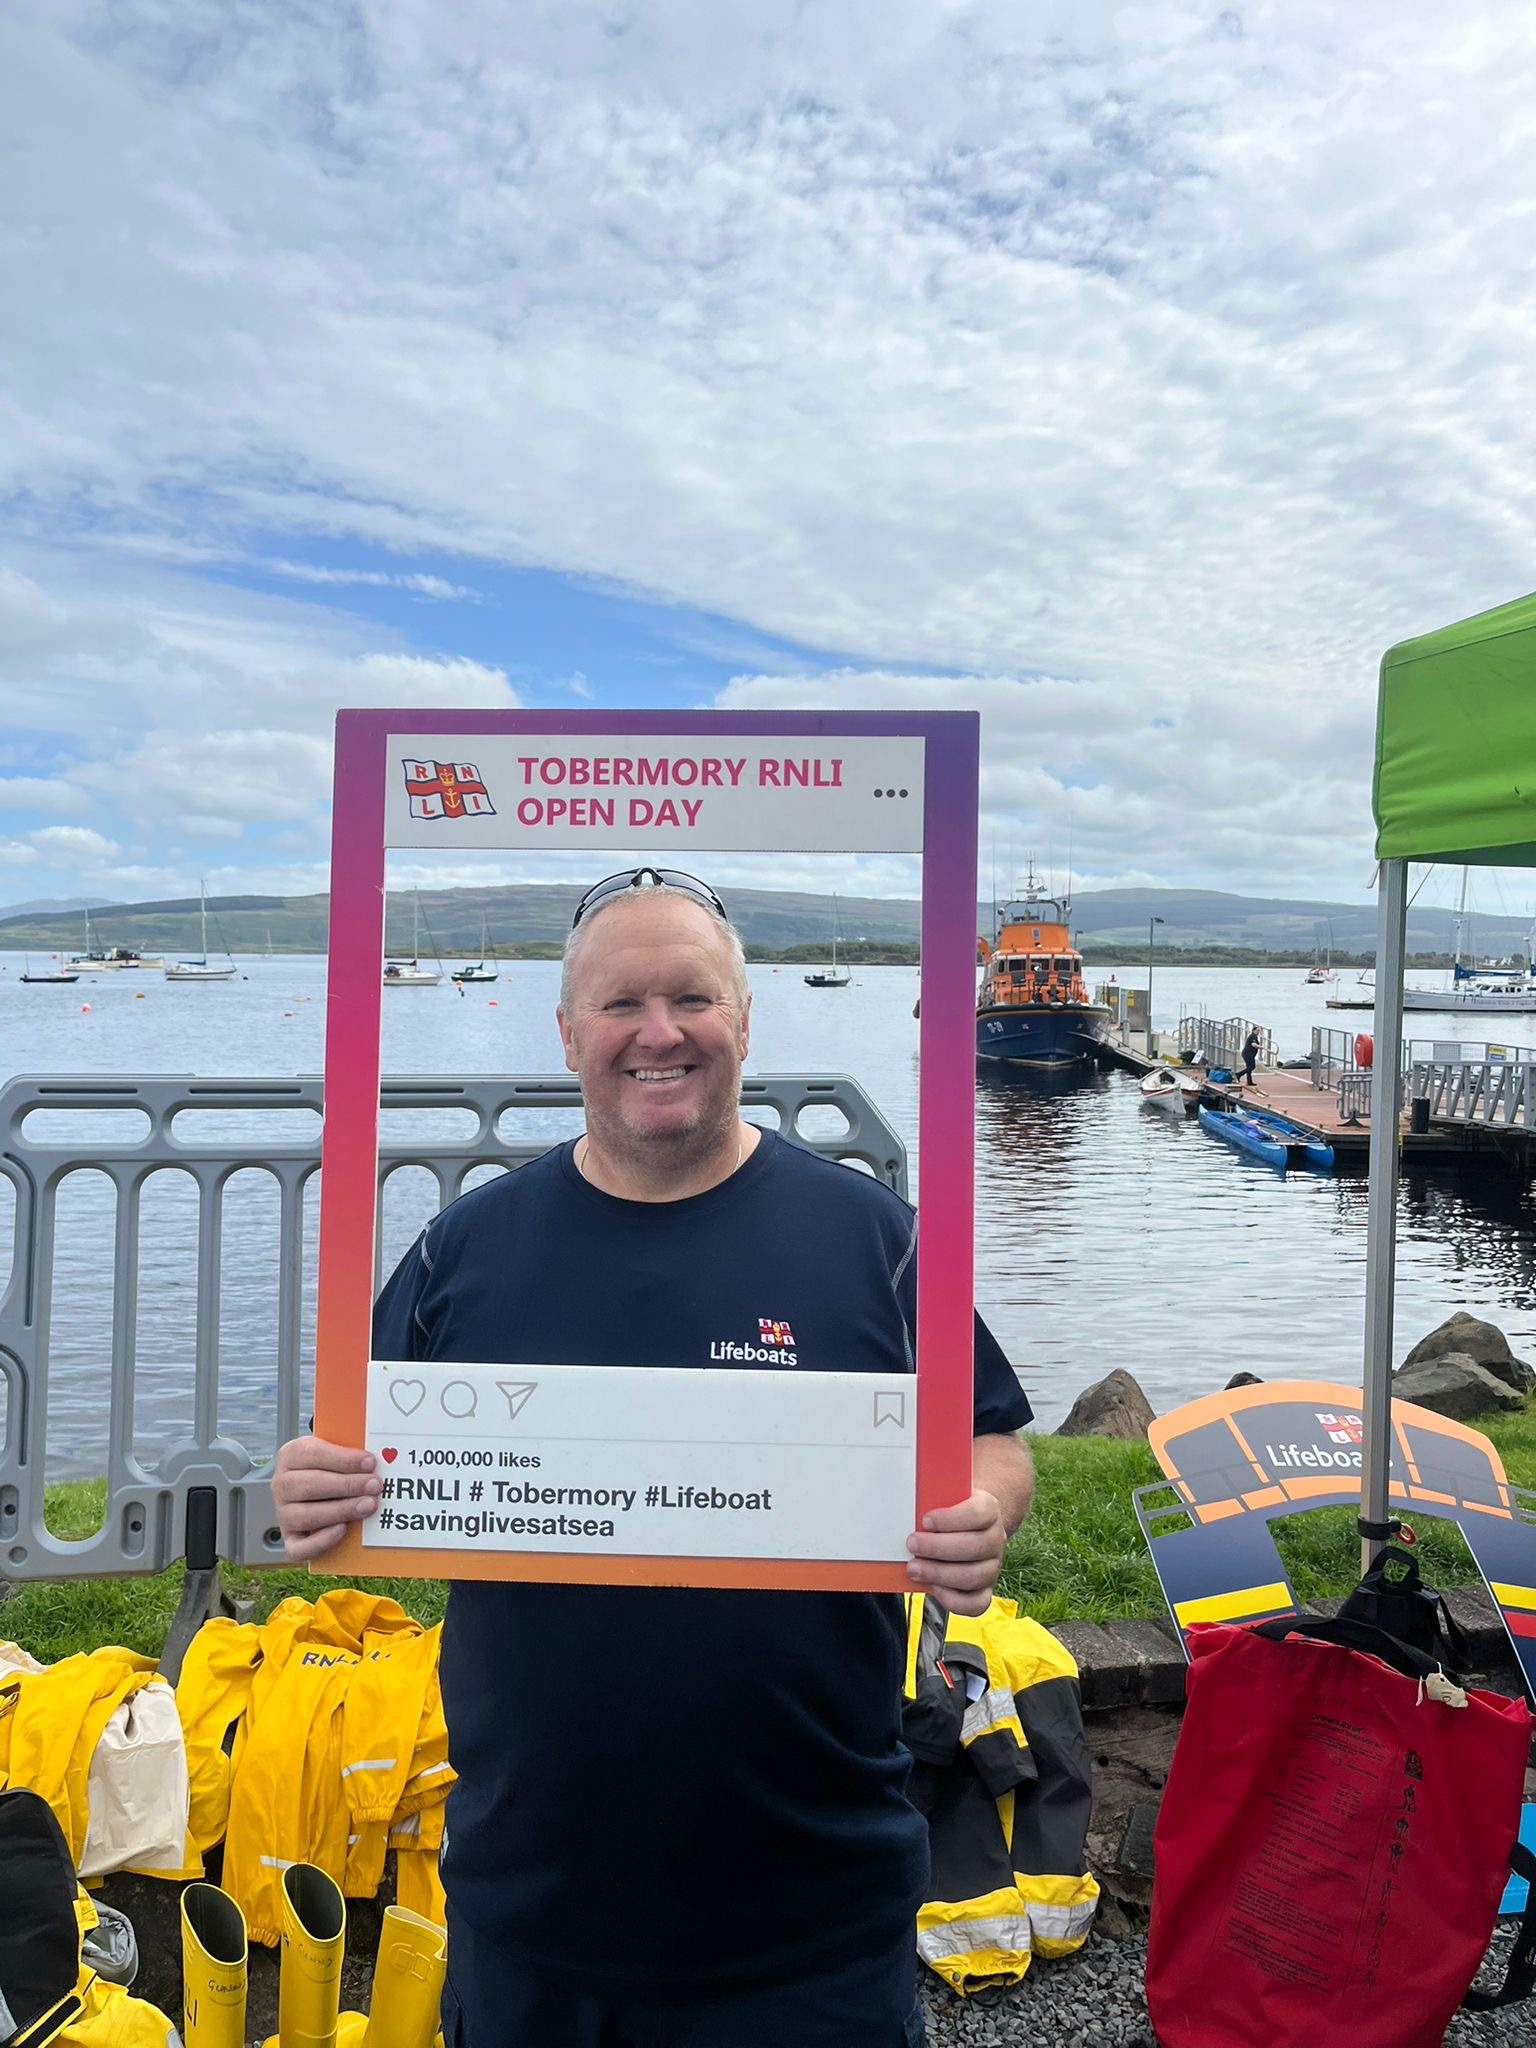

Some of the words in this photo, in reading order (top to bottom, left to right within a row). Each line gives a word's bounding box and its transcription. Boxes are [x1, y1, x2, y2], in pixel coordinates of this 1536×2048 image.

[518, 757, 745, 787] TOBERMORY
[758, 758, 842, 788] RNLI
[517, 798, 615, 827] OPEN
[628, 799, 703, 828] DAY
[710, 1341, 797, 1366] Lifeboats
[409, 1449, 493, 1468] 1,000,000
[498, 1451, 541, 1468] likes
[1265, 1444, 1394, 1468] Lifeboa
[382, 1478, 460, 1501] #RNLI
[469, 1480, 484, 1502] #
[492, 1480, 637, 1512] Tobermory
[645, 1486, 772, 1511] #Lifeboat
[379, 1508, 615, 1538] #savinglivesatsea
